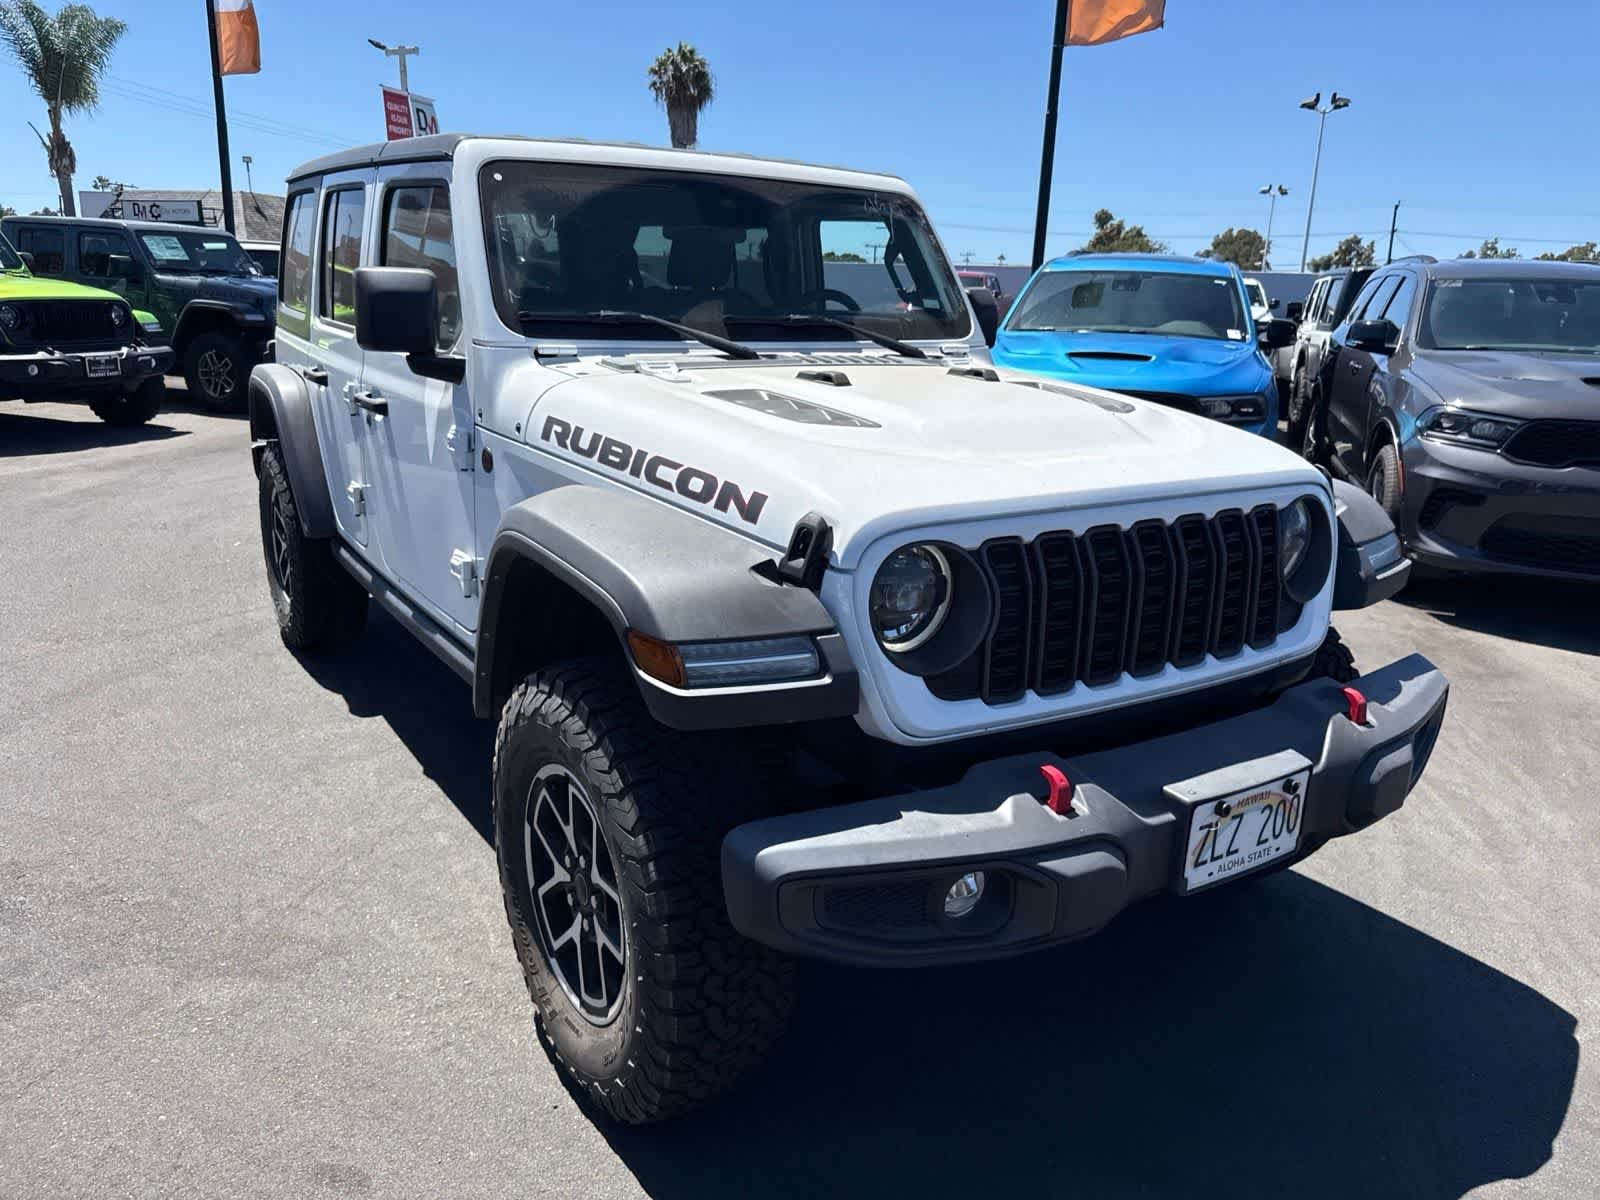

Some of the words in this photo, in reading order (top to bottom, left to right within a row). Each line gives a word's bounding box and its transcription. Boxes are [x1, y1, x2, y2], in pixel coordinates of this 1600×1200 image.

[541, 415, 768, 525] RUBICON
[1236, 791, 1272, 809] HAWAII
[1256, 794, 1300, 846] 200
[1217, 858, 1245, 874] ALOHA
[1247, 846, 1273, 863] STATE
